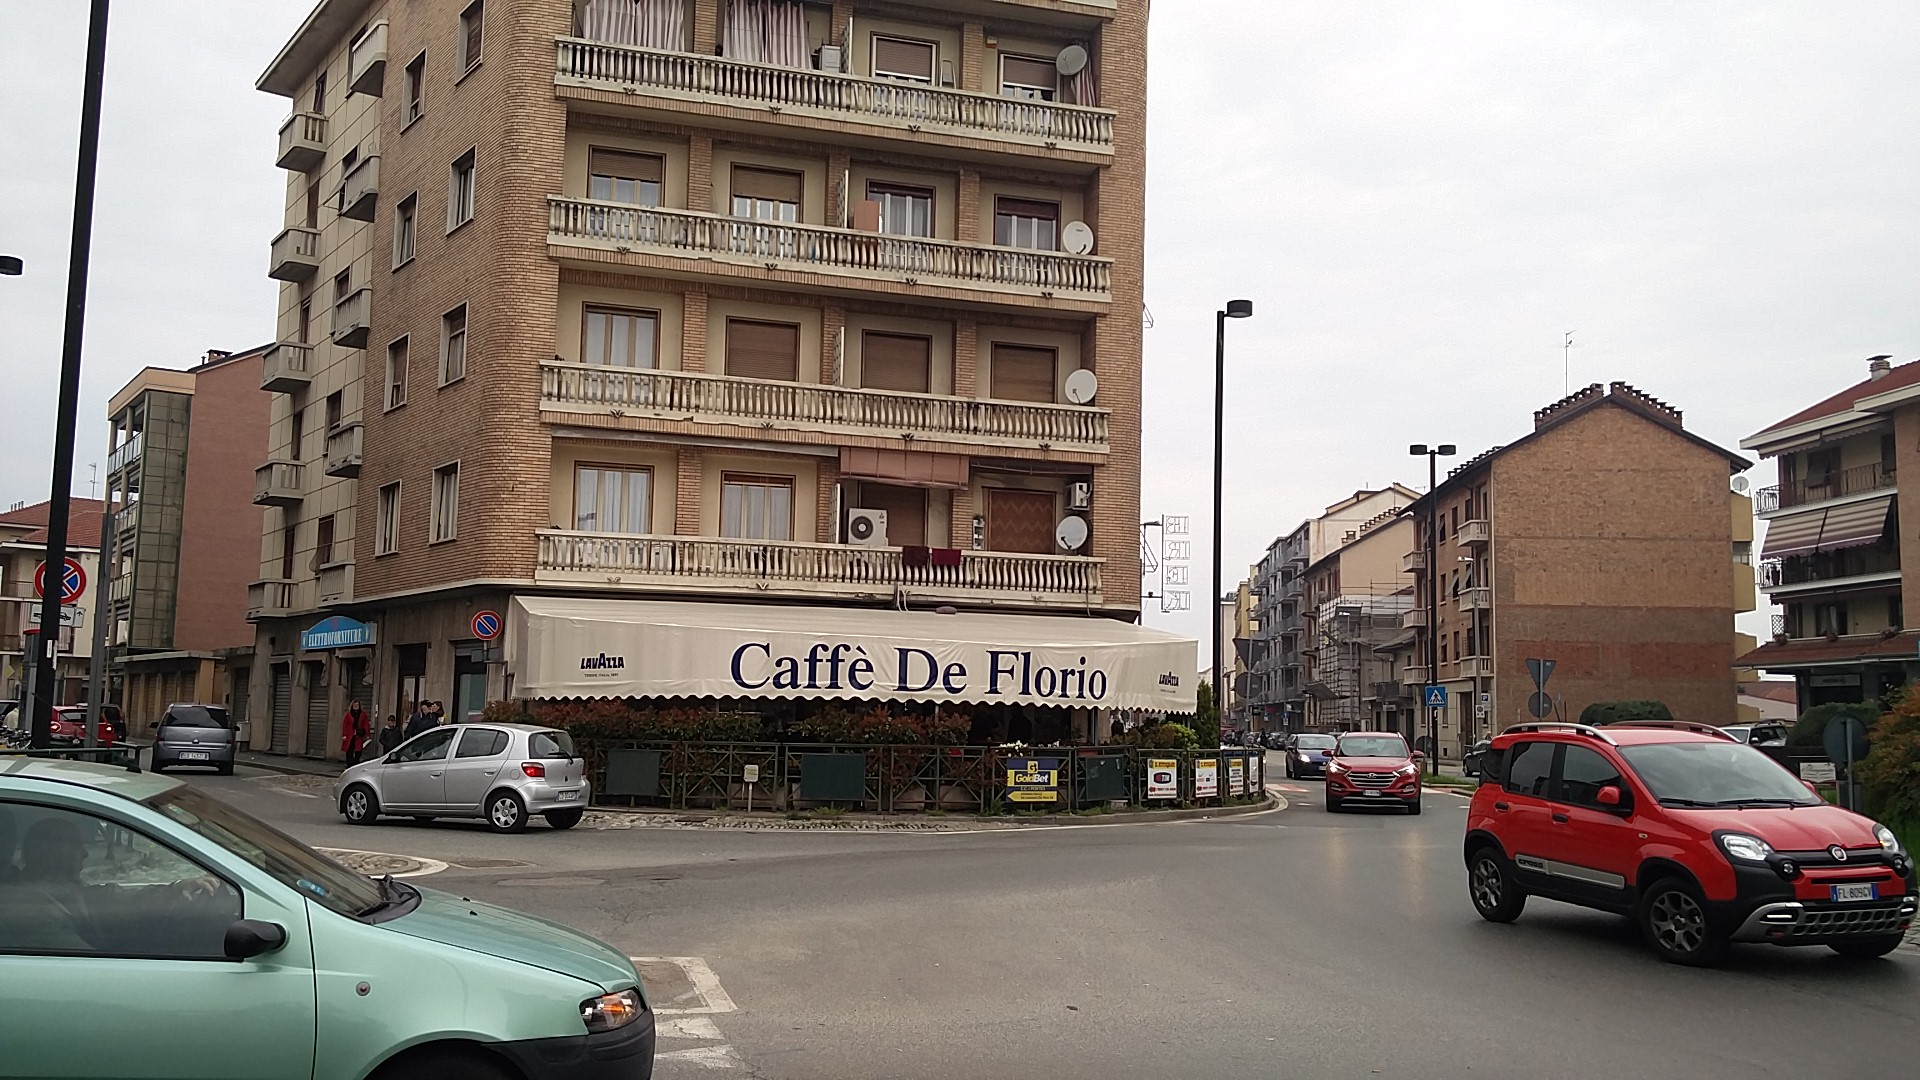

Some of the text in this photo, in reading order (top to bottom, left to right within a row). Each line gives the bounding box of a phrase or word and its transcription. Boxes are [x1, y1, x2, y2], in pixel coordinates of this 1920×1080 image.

[580, 653, 625, 669] LAVAZZA
[730, 642, 1107, 700] Caffè De Florio
[1158, 671, 1179, 686] LAVAZZA
[1015, 773, 1049, 783] GoldBet
